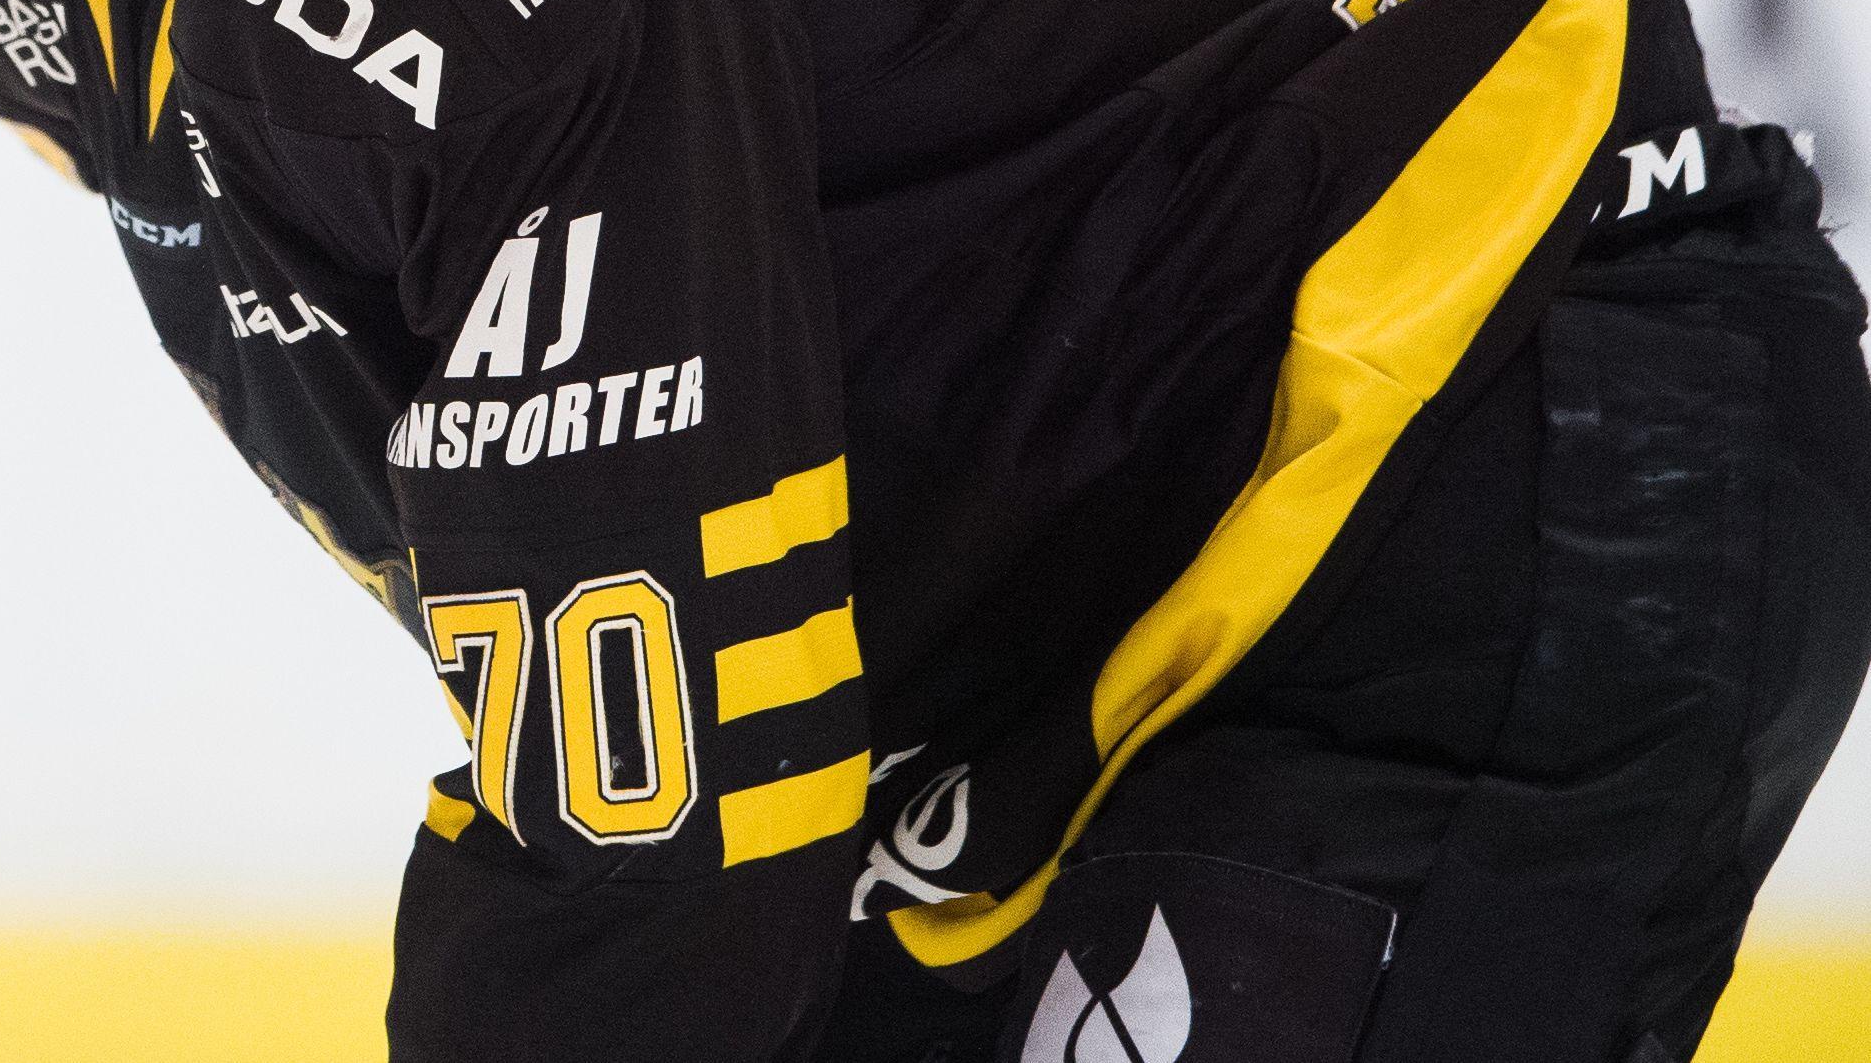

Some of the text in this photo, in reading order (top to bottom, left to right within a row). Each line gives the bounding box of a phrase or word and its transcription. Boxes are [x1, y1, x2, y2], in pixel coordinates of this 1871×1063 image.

[110, 197, 202, 247] CCM
[444, 206, 602, 378] ÅJ
[422, 569, 698, 847] 70
